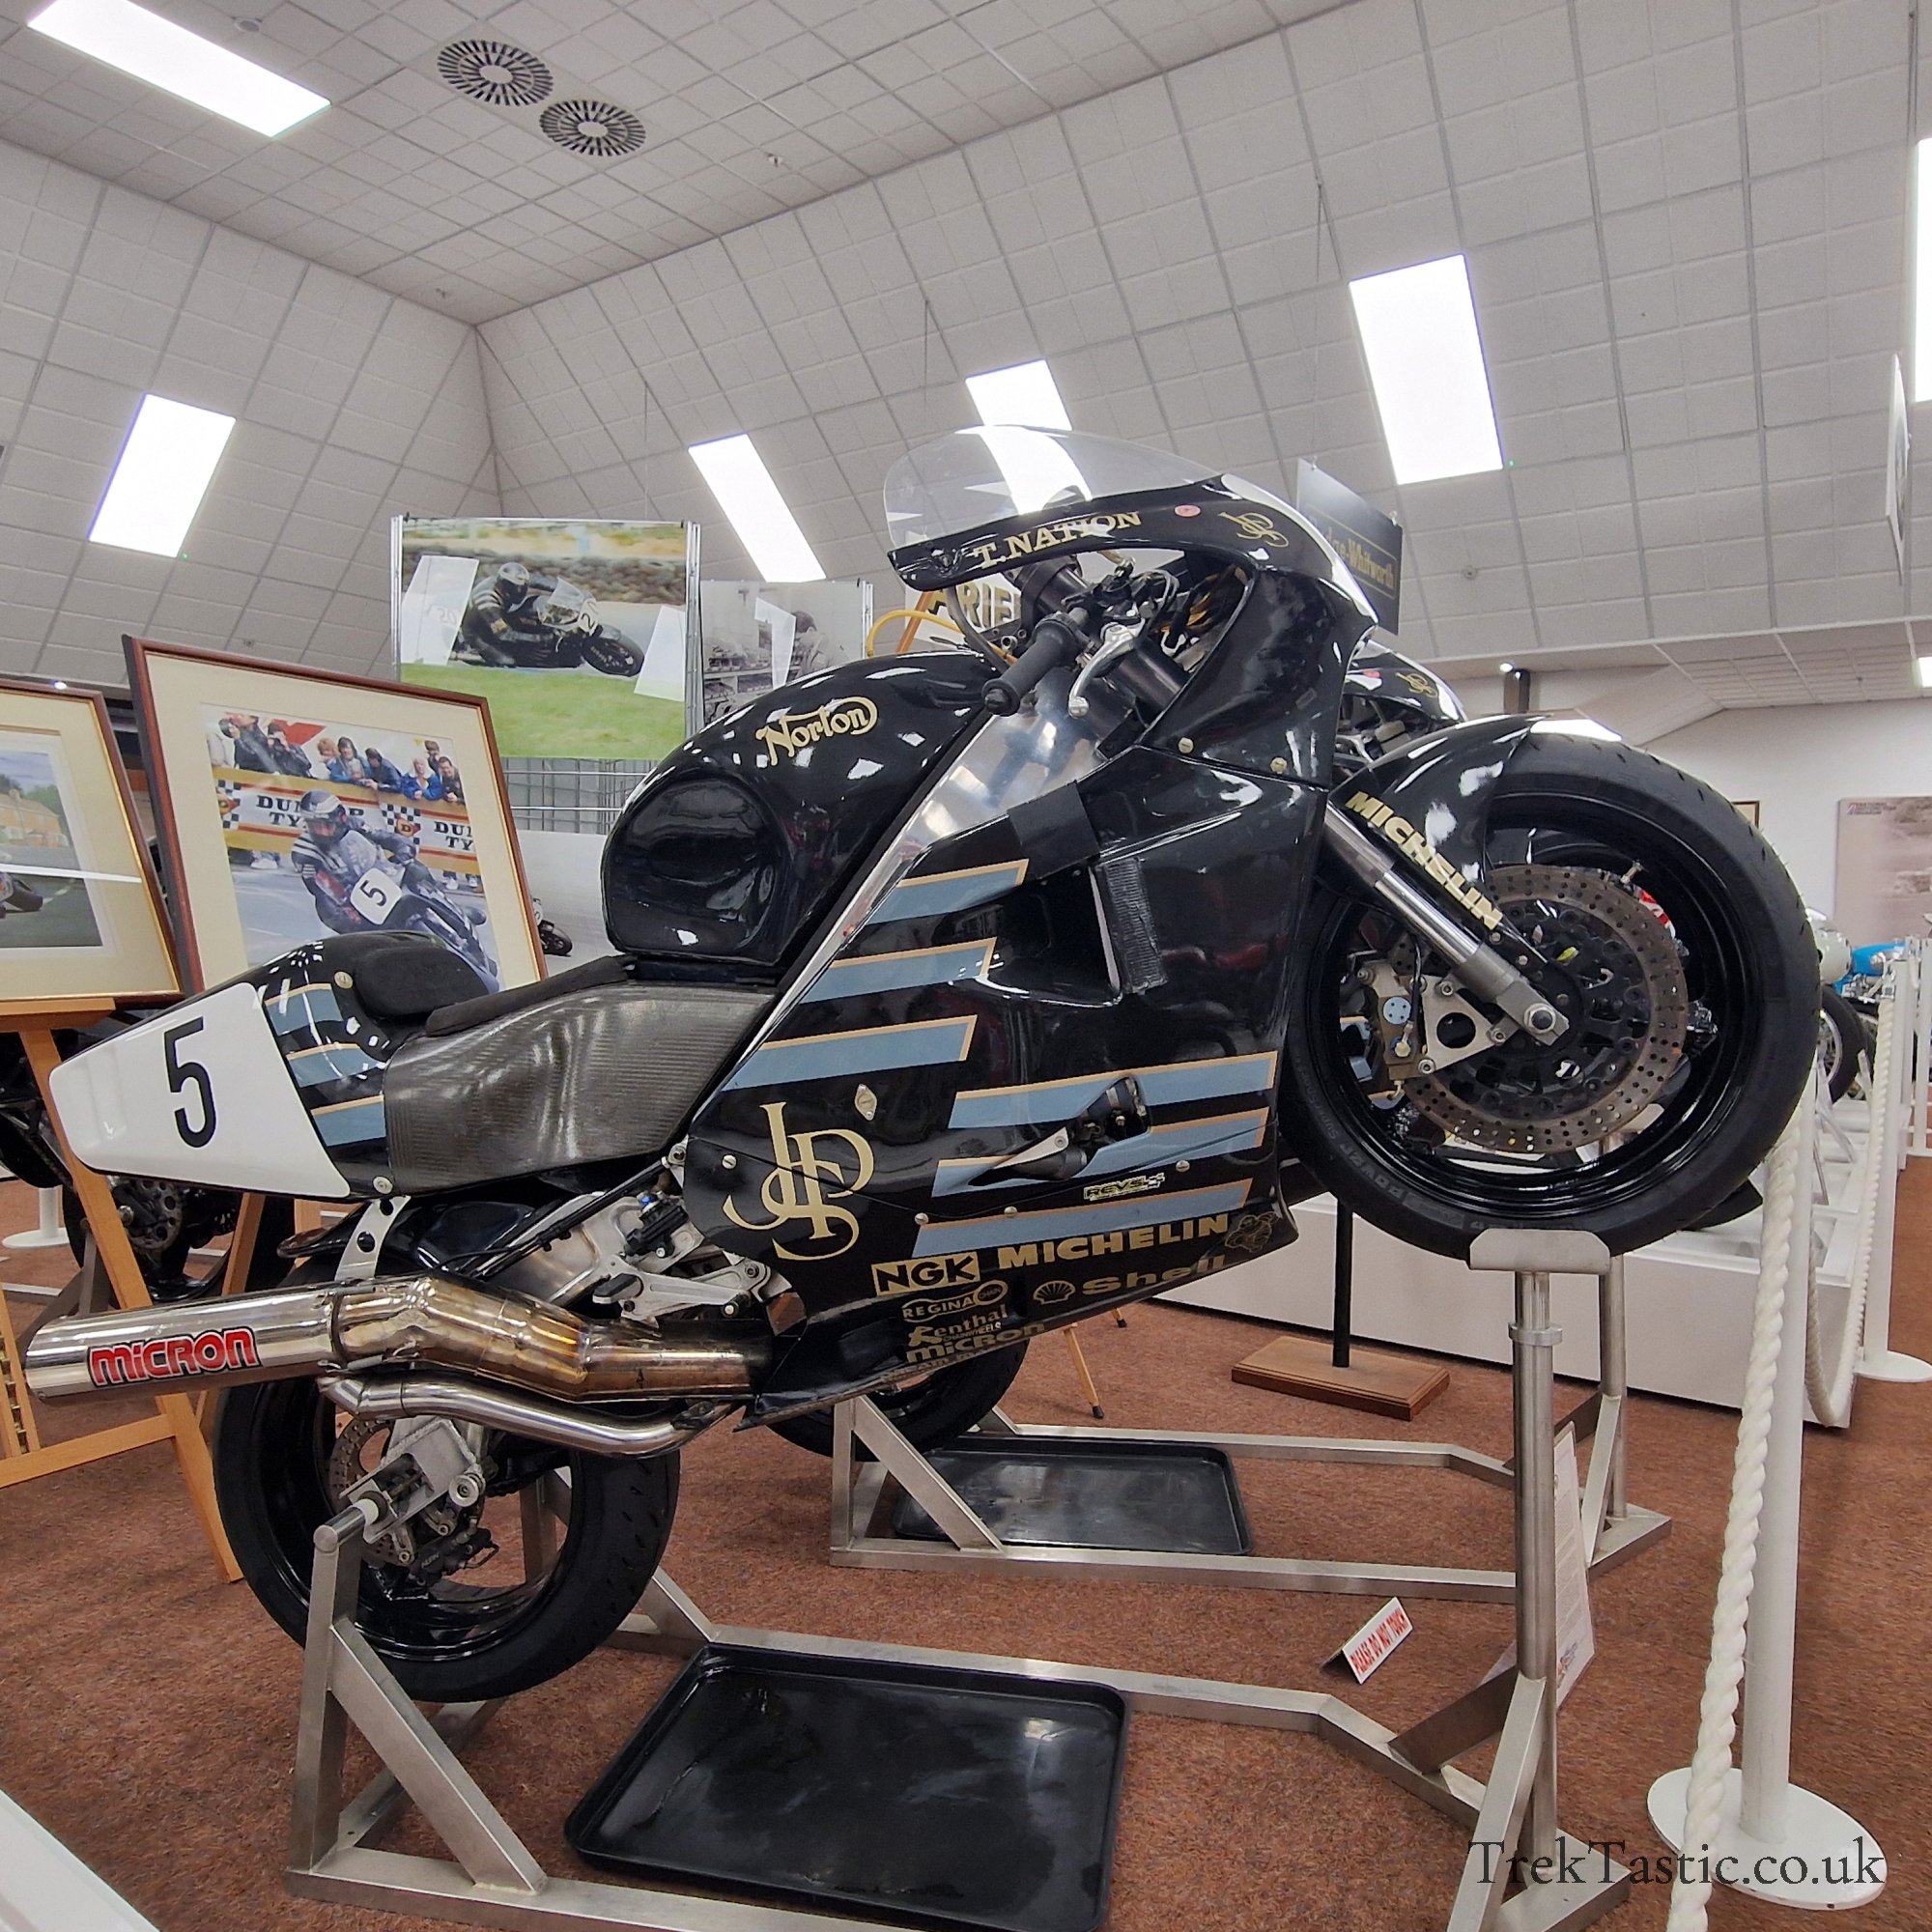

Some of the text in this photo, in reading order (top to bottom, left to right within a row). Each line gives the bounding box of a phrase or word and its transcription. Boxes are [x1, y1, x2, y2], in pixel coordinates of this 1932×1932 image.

[974, 511, 1143, 570] T.NATION
[754, 696, 878, 767] Norton
[1344, 791, 1504, 931] MICHELIN
[358, 879, 387, 907] 5
[163, 1015, 216, 1149] 5
[998, 1213, 1230, 1269] MICHELIN
[875, 1255, 977, 1293] NGK
[1082, 1254, 1226, 1296] Shell
[901, 1296, 975, 1319] REGINA
[908, 1304, 1009, 1348] Renthal
